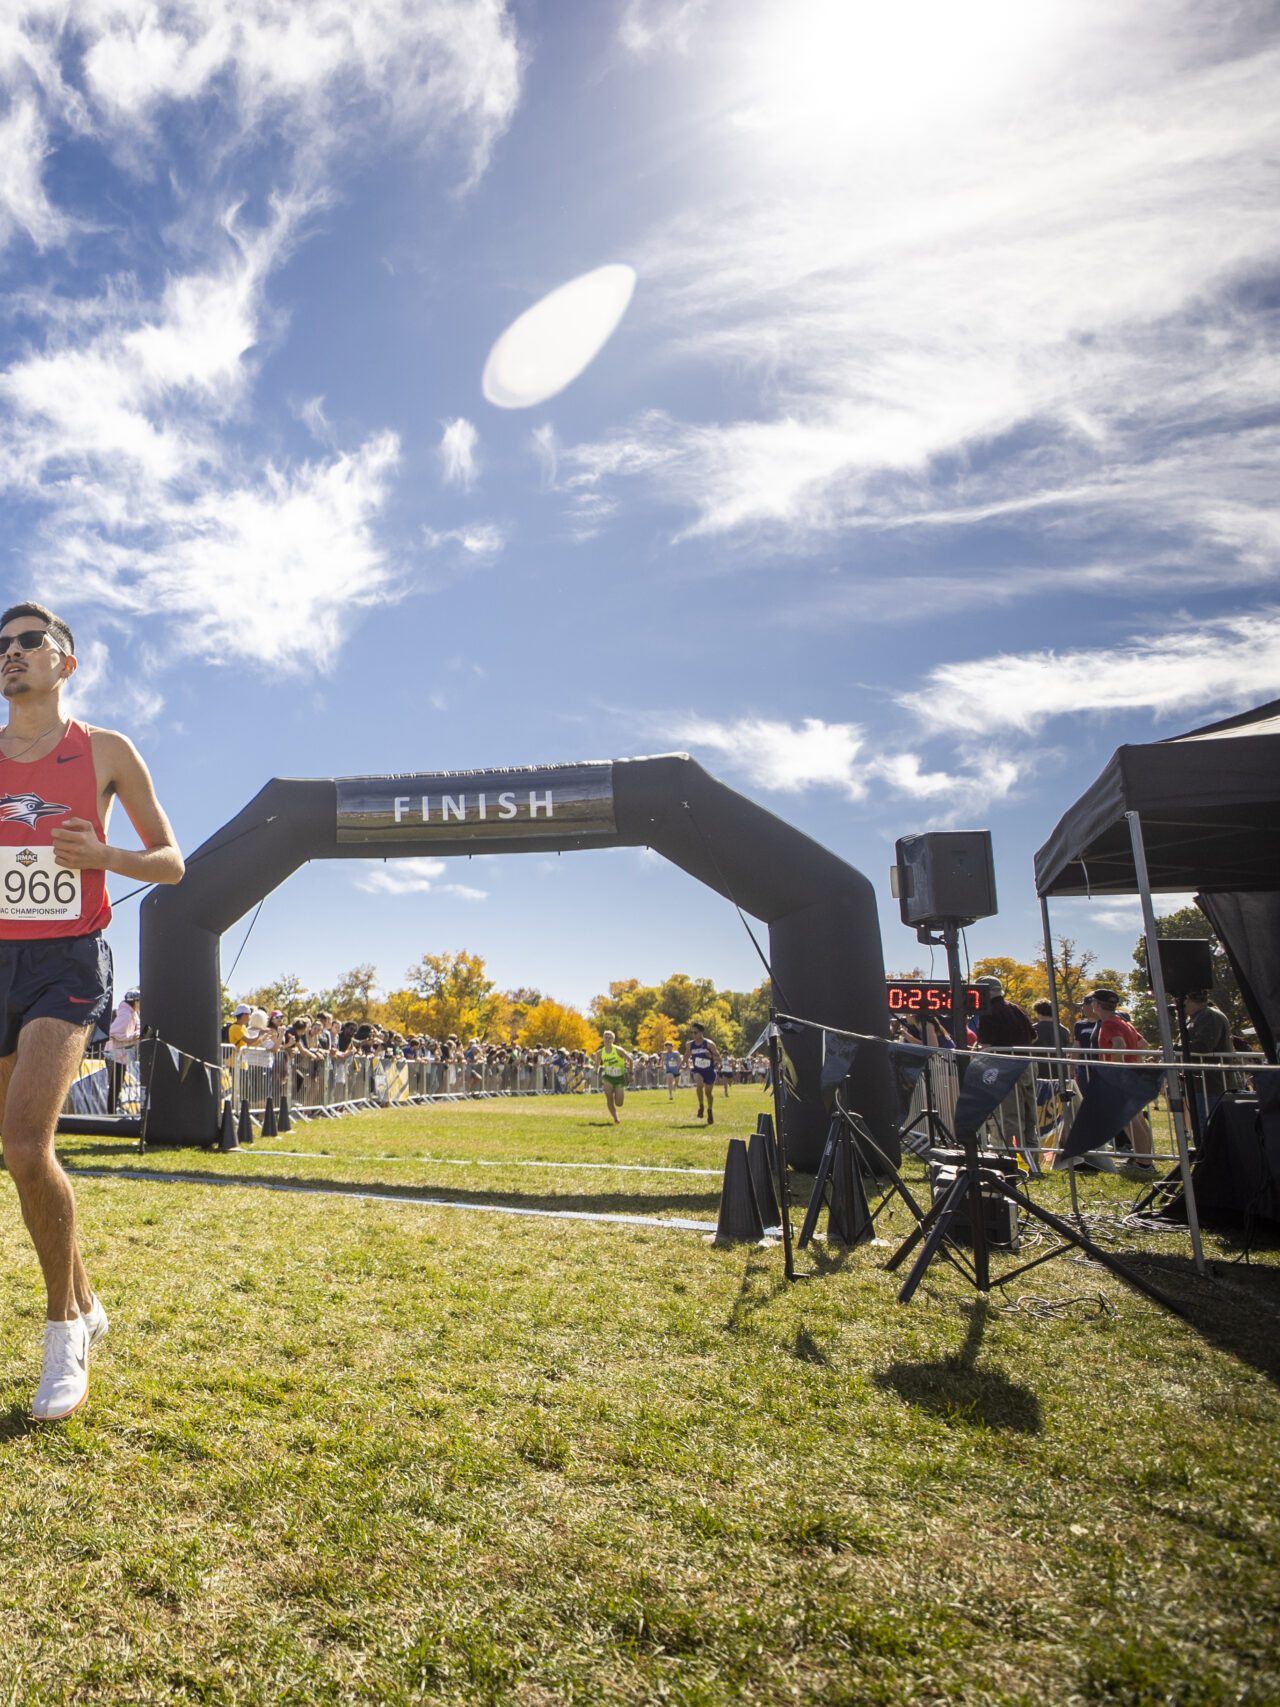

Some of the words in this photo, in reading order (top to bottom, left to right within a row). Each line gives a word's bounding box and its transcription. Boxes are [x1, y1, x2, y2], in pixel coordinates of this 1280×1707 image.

[394, 791, 553, 822] FINISH
[16, 854, 37, 862] RMAC
[10, 907, 68, 915] CHAMPIONSHIP
[889, 988, 980, 1010] 0:25:7
